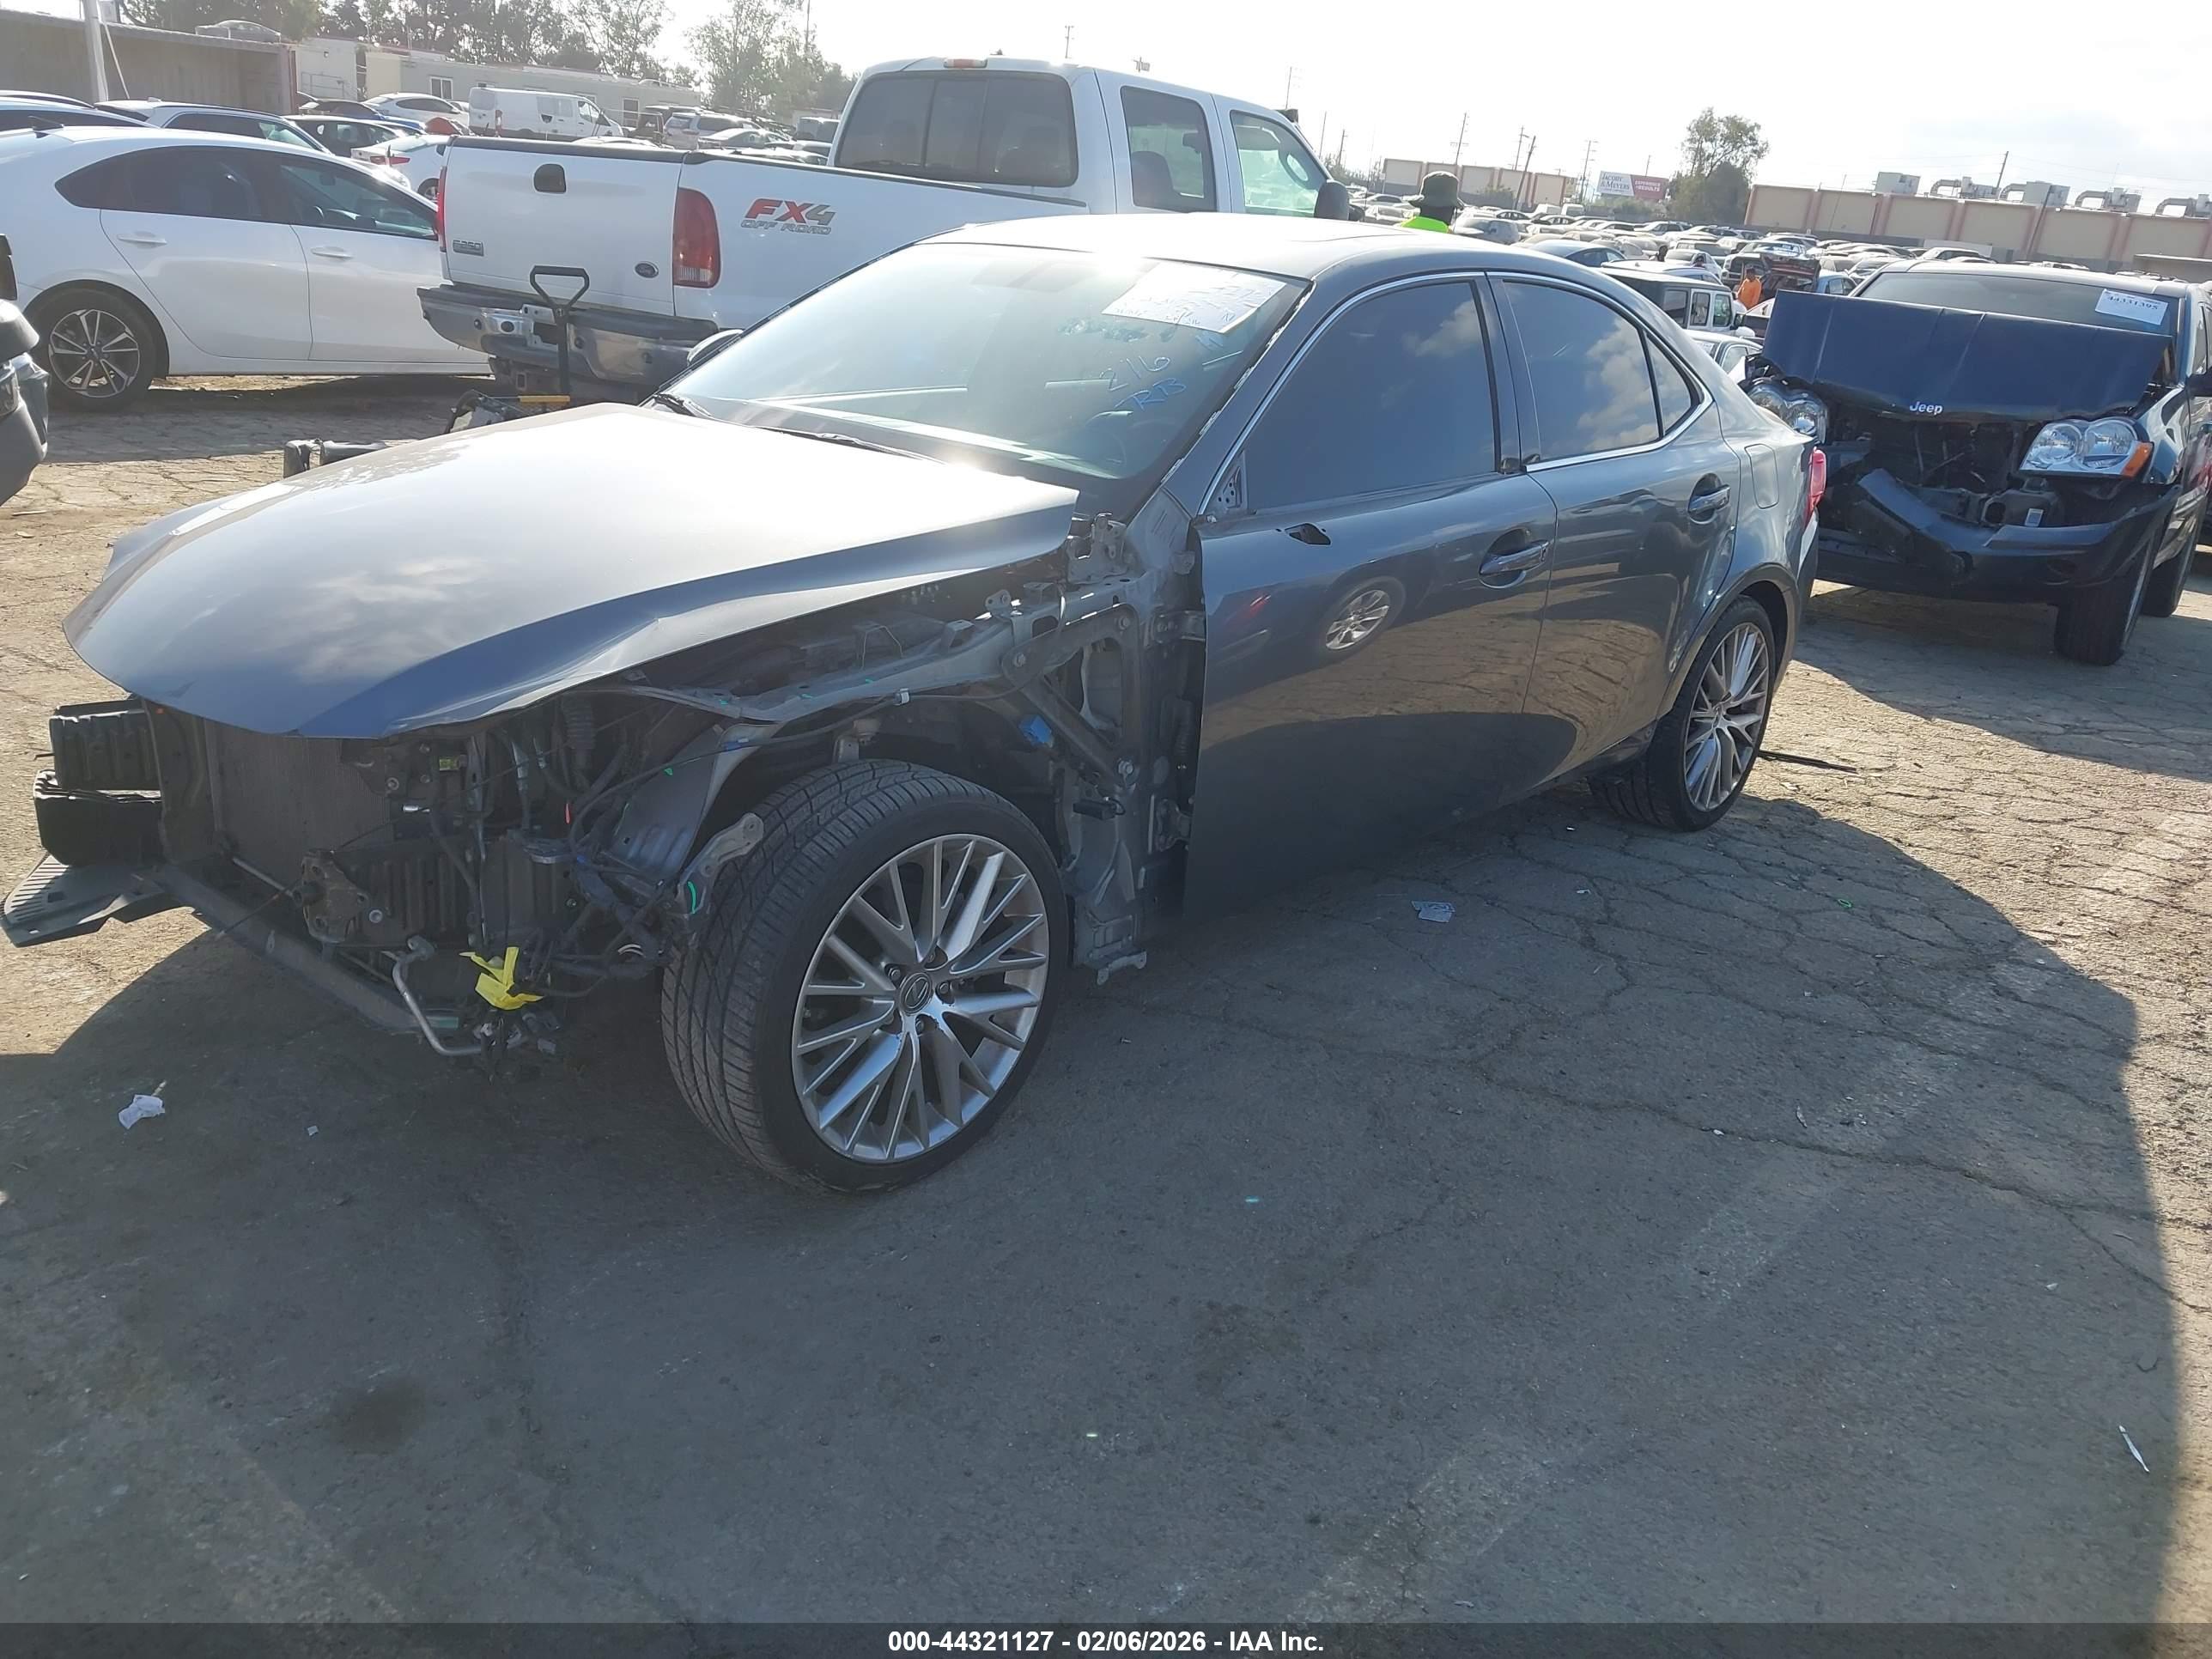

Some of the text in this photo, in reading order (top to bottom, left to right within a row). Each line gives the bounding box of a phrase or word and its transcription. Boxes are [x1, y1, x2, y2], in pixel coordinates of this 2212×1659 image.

[744, 198, 836, 226] FX4
[740, 220, 832, 235] OFF ROAD
[1099, 356, 1171, 392] 216
[1910, 401, 1943, 416] Jeep
